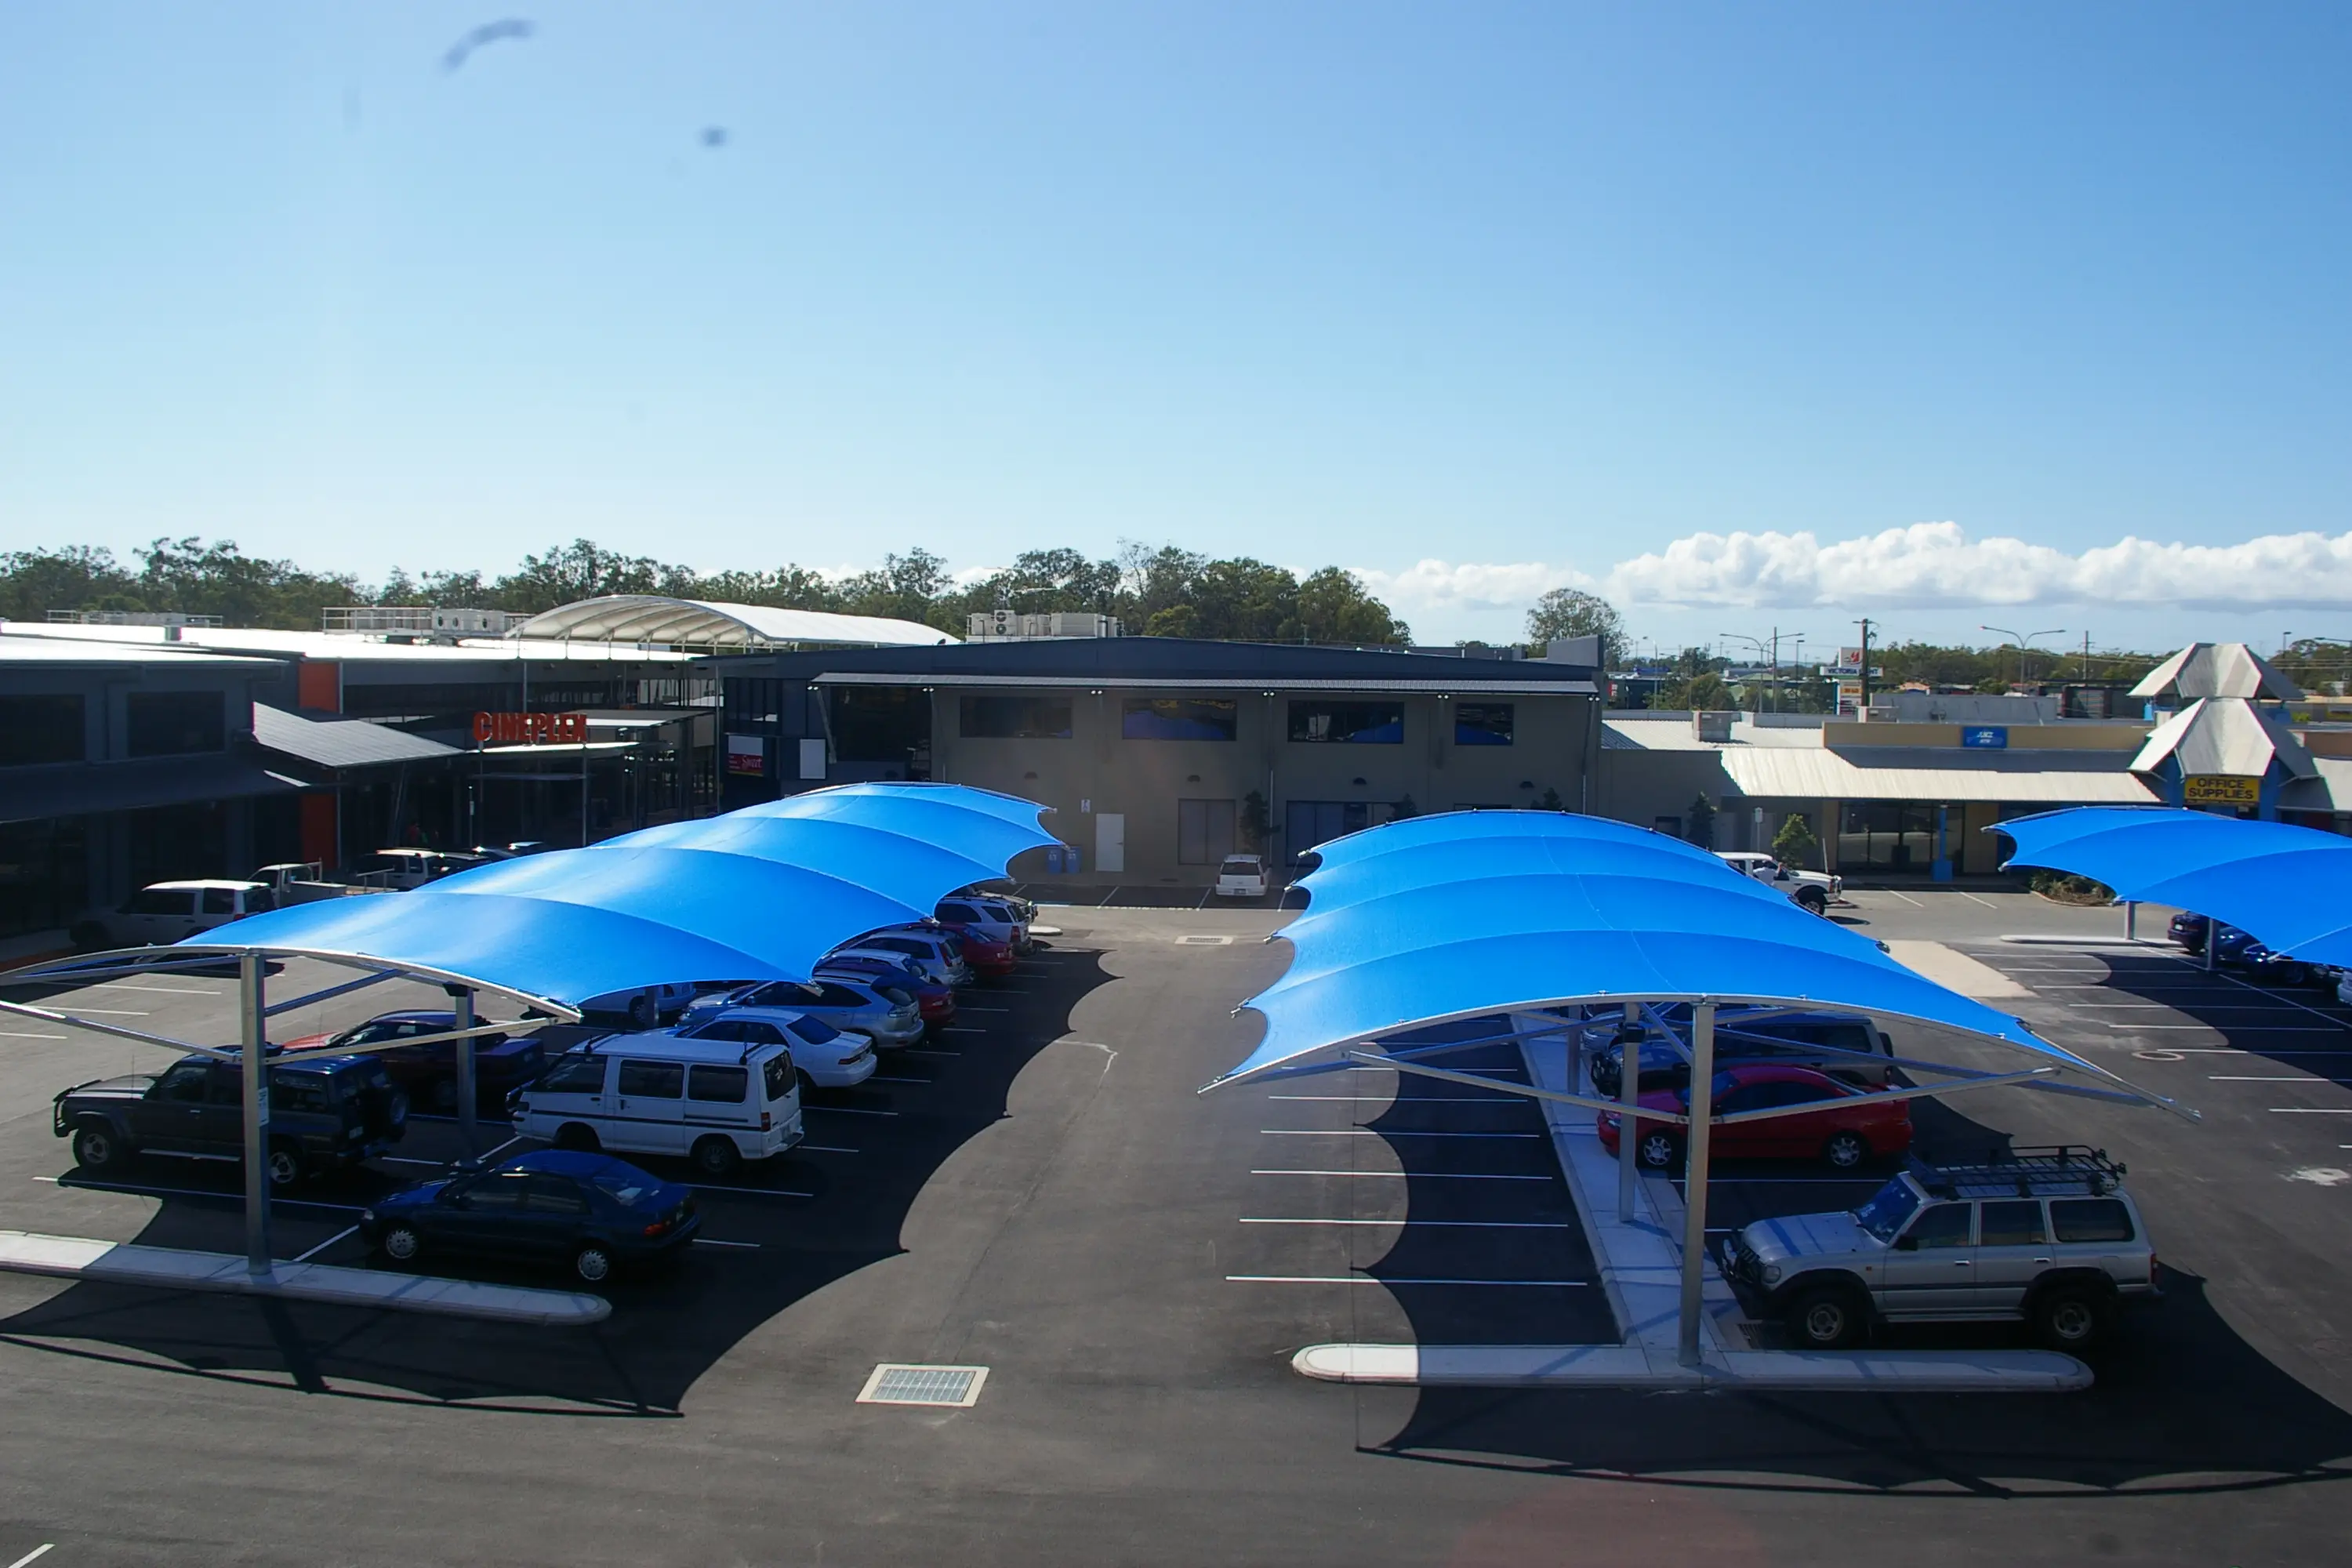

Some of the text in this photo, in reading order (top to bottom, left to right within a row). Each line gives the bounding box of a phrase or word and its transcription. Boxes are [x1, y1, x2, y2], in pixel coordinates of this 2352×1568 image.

[473, 711, 587, 742] CINEPLEX
[2197, 778, 2245, 789] OFFICE
[2188, 787, 2254, 800] SUPPLIES
